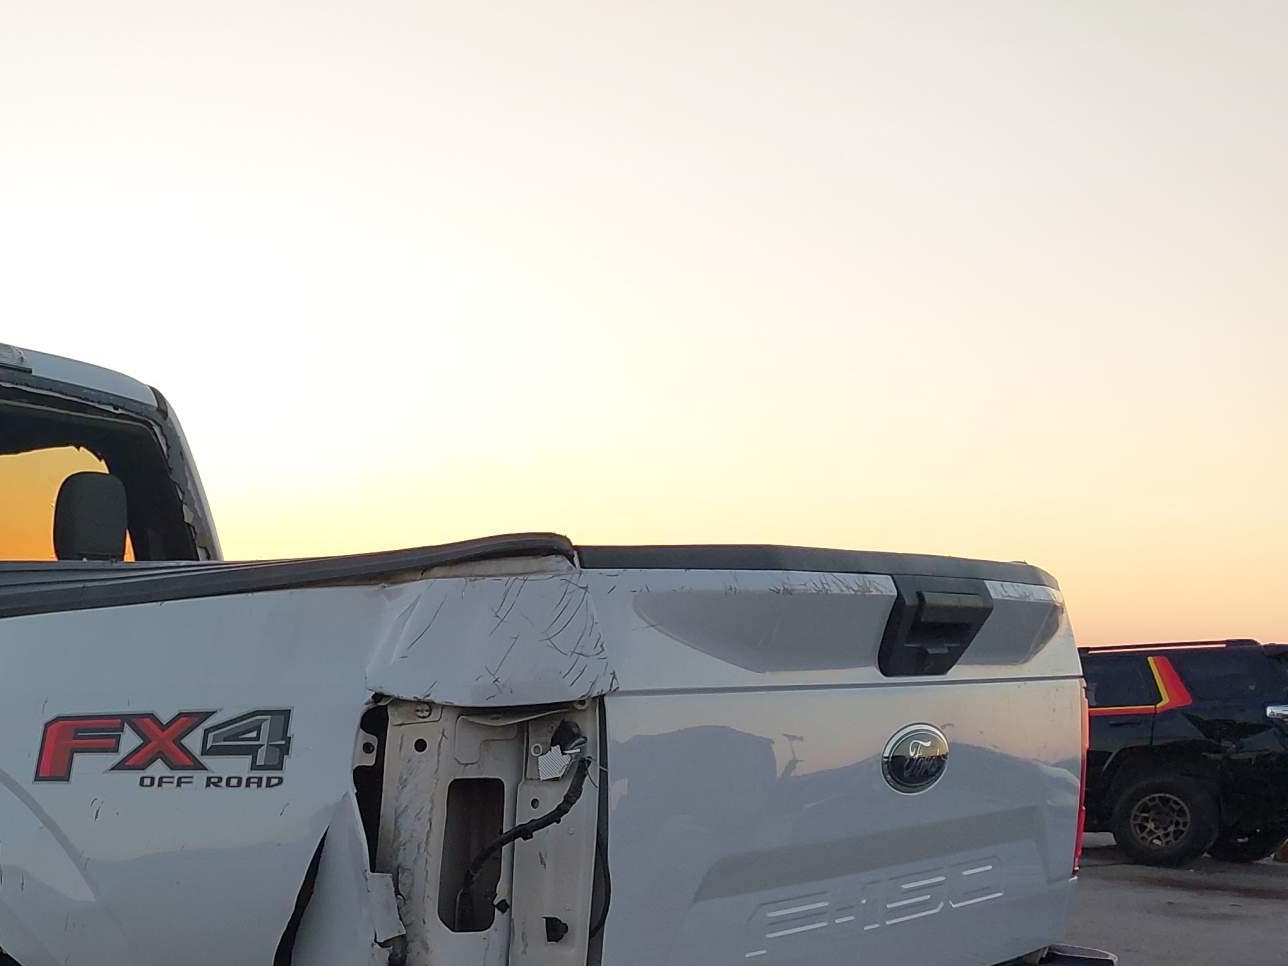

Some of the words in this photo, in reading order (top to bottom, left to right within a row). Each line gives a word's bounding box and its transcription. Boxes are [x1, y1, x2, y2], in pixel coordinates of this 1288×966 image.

[34, 708, 292, 782] FX4
[139, 775, 194, 788] OFF
[205, 775, 284, 788] ROAD
